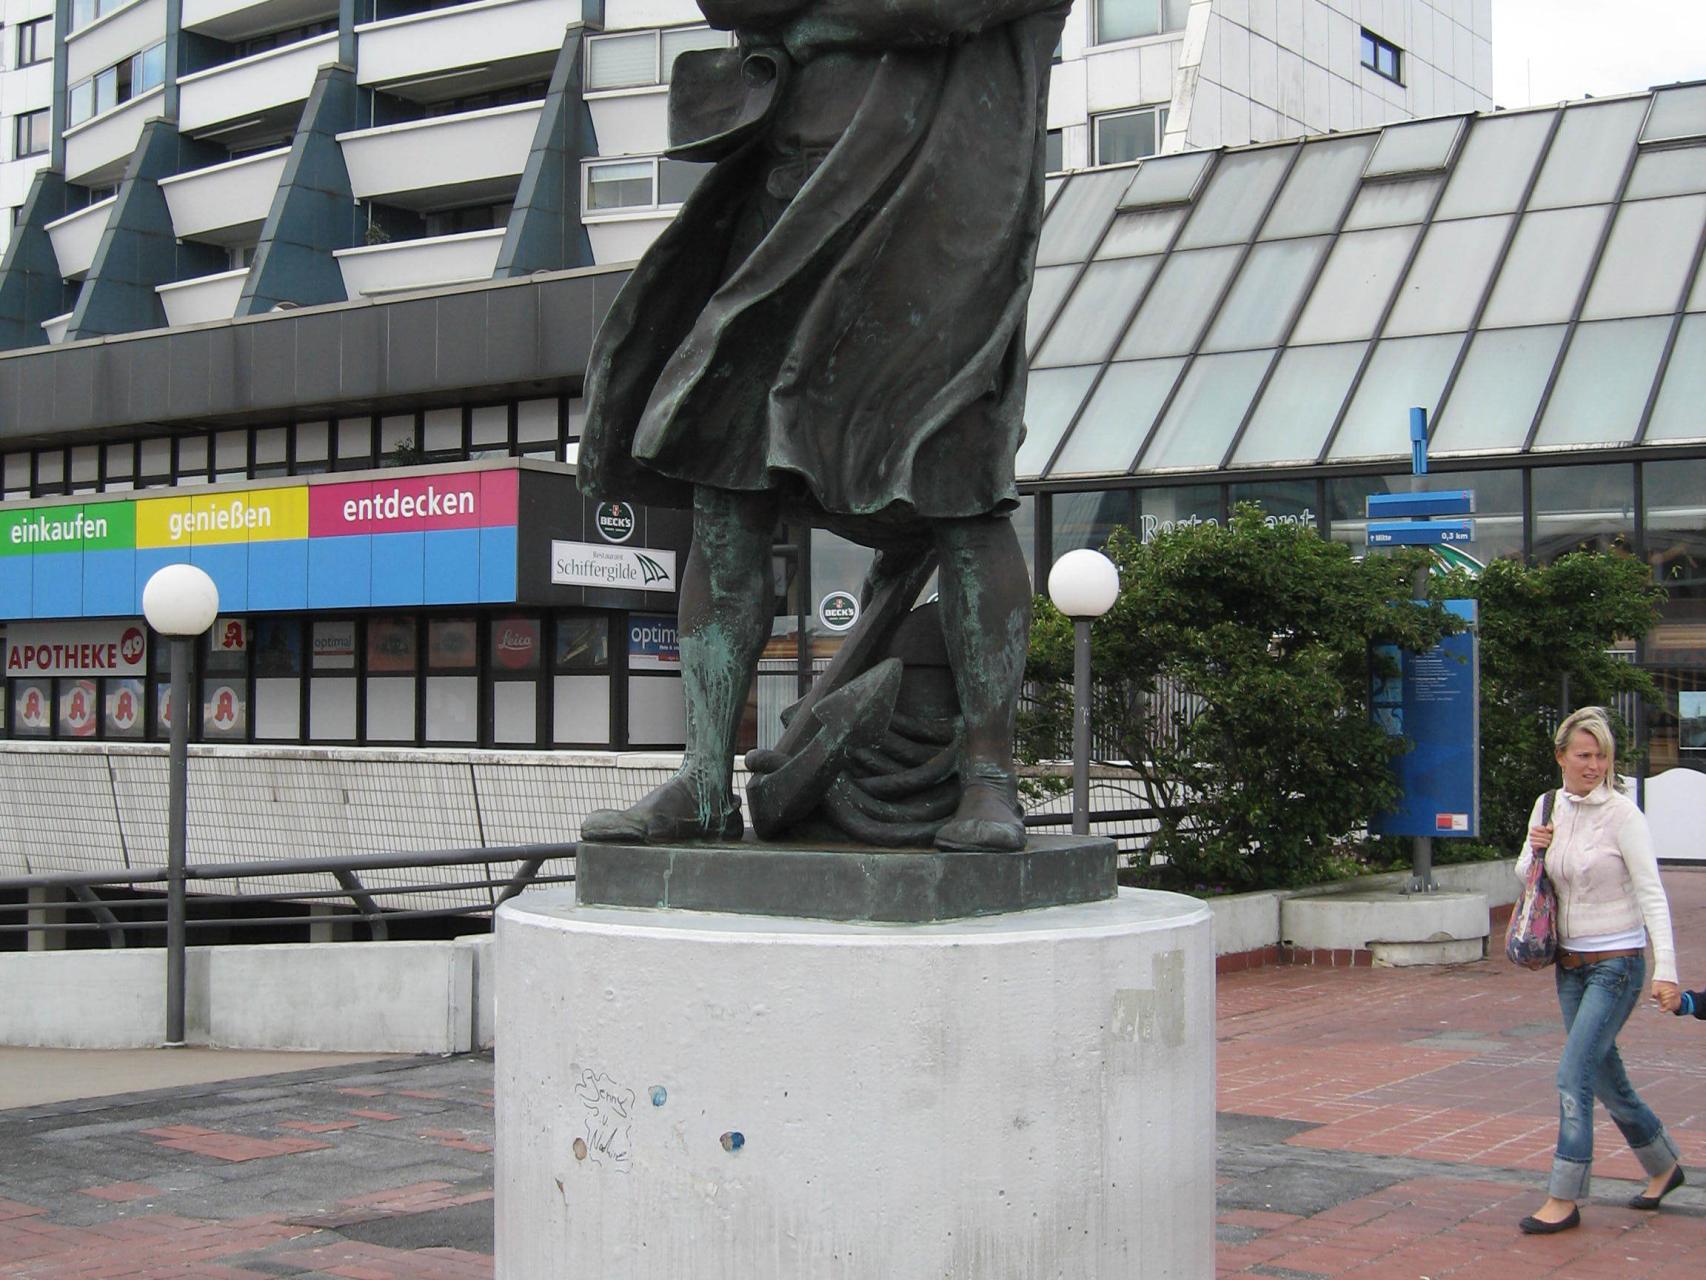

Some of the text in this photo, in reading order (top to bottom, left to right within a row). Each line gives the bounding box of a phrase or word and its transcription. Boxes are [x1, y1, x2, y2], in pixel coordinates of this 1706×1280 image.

[343, 486, 475, 521] entdecken
[11, 513, 107, 545] einkaufen
[169, 501, 271, 540] genießen
[600, 515, 631, 528] BECK'S
[1441, 532, 1468, 541] 0,3 km
[557, 558, 637, 582] Schiffergilde
[825, 607, 854, 617] BECK'S
[498, 629, 532, 650] Leica
[8, 644, 117, 670] APOTHEKE
[580, 1075, 628, 1118] Jenny
